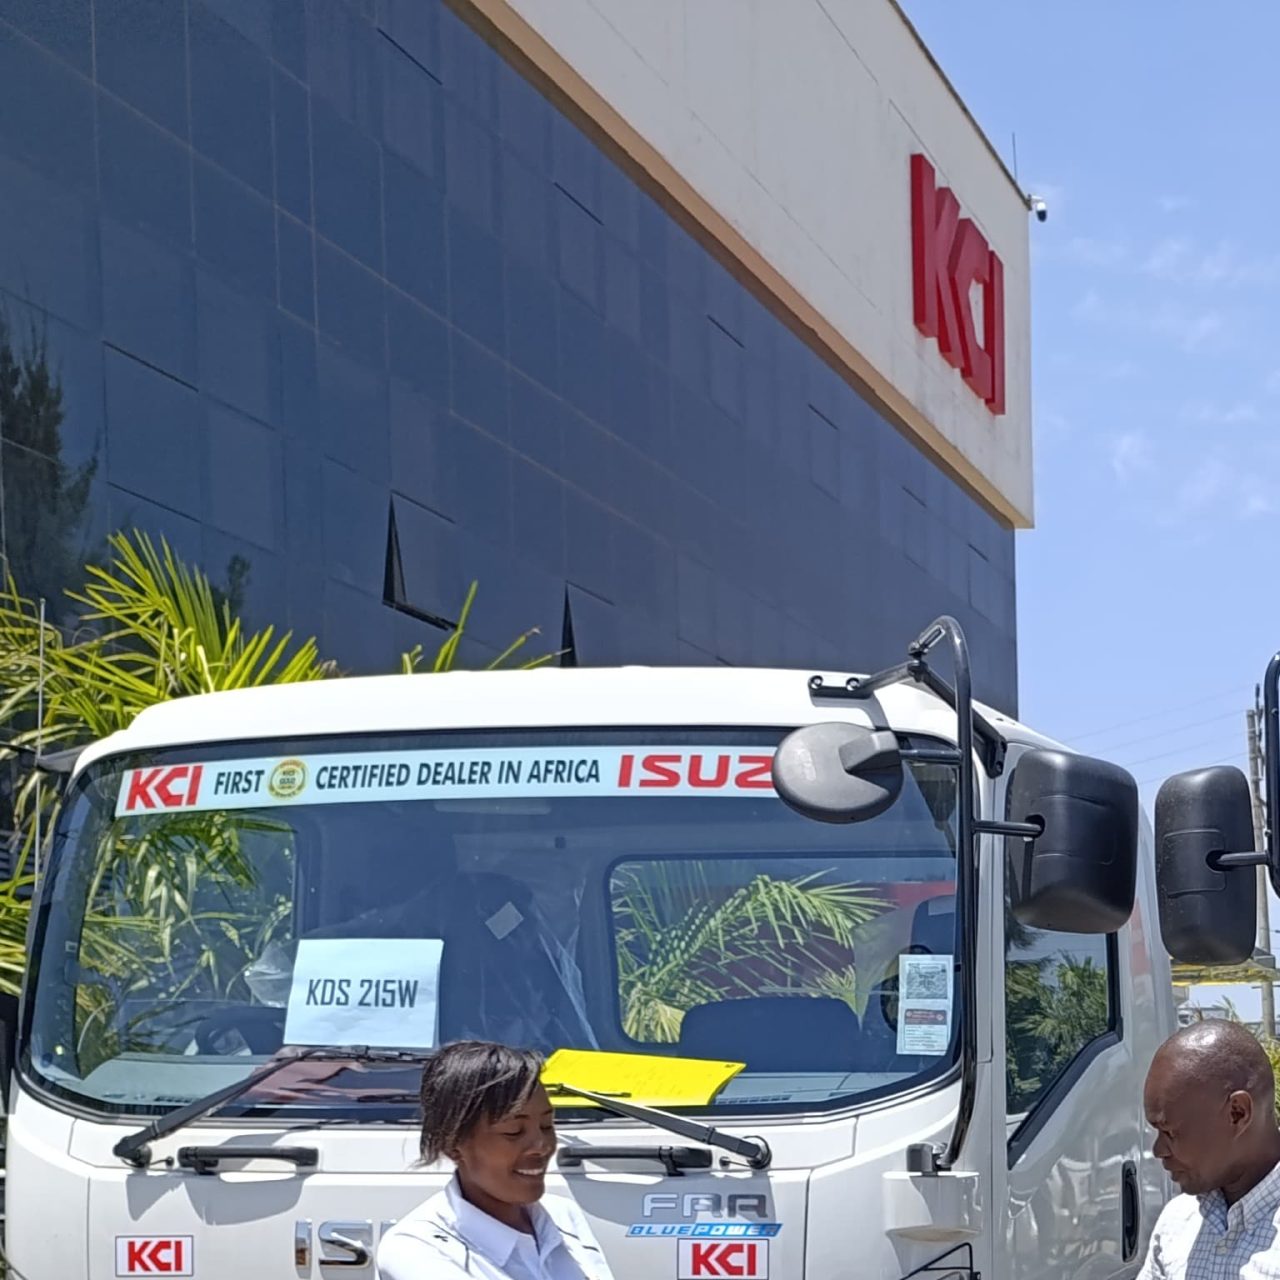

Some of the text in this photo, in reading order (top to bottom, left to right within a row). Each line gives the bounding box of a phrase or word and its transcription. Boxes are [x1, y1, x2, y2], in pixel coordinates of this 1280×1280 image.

[911, 153, 1005, 415] KCI
[125, 765, 203, 811] KCI
[213, 770, 264, 795] FIRST
[315, 763, 410, 789] CERTIFIED
[416, 761, 492, 786] DEALER
[497, 760, 522, 784] IN
[527, 759, 600, 783] AFRICA
[617, 754, 775, 789] ISUZ
[306, 979, 418, 1008] KDS 215W
[128, 1241, 182, 1272] KCI
[295, 1219, 397, 1267] IS
[692, 1243, 757, 1276] KCI
